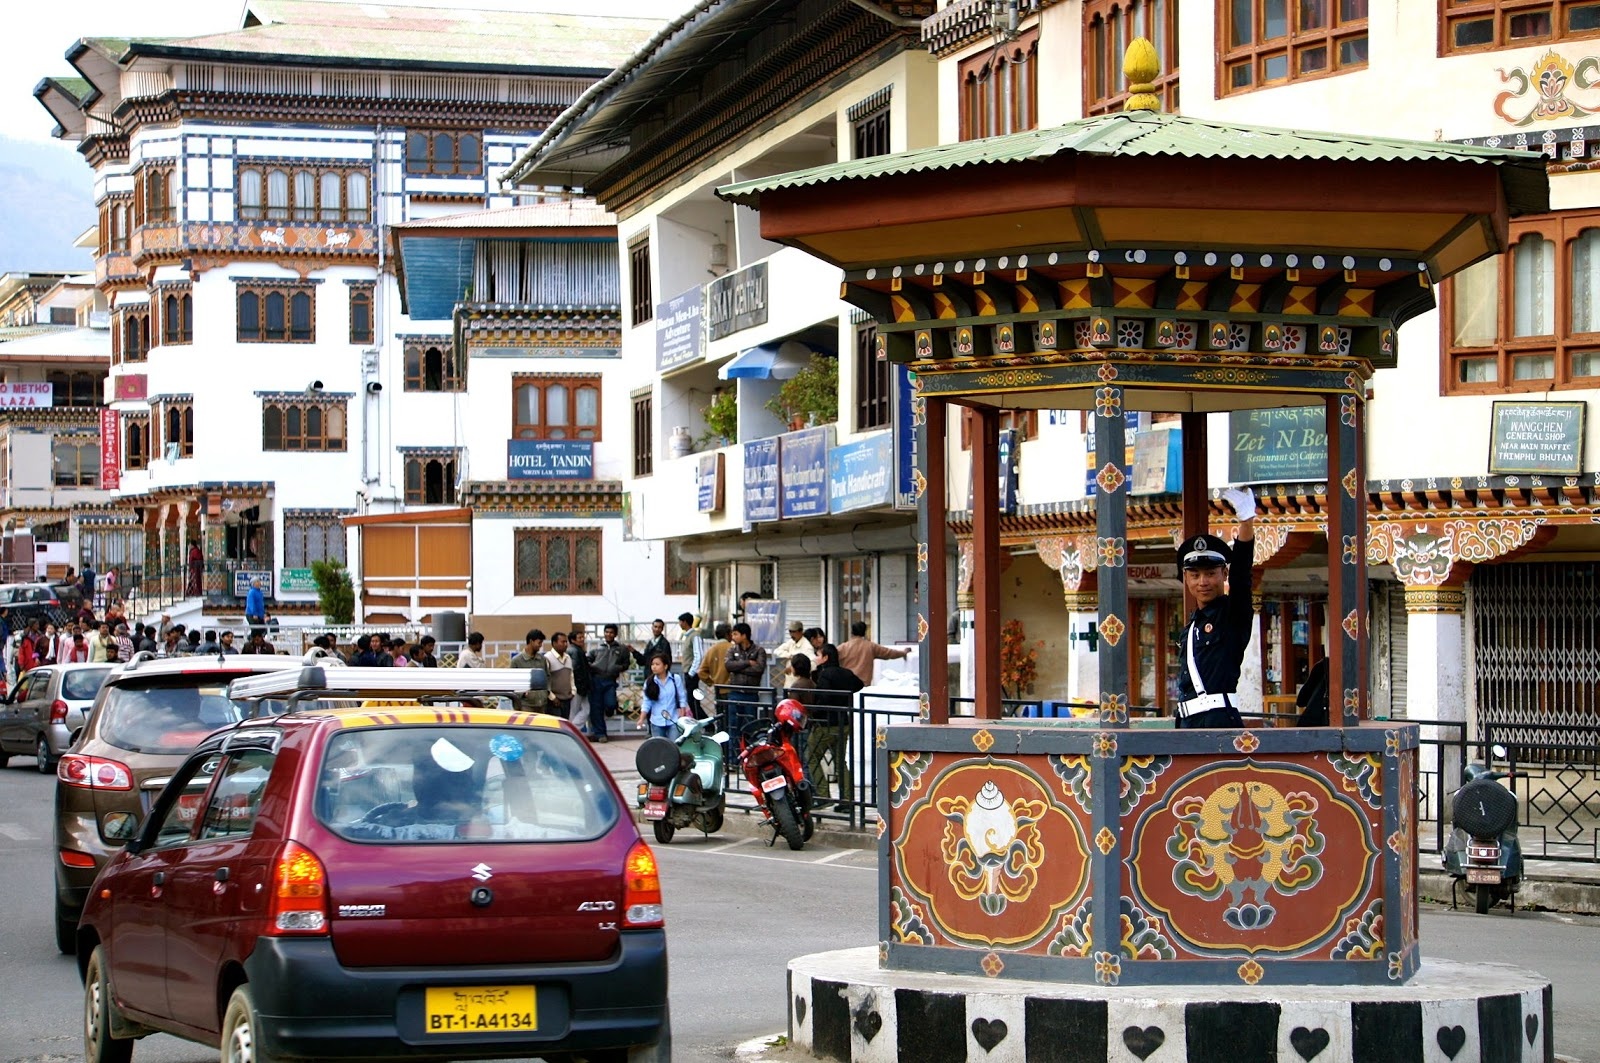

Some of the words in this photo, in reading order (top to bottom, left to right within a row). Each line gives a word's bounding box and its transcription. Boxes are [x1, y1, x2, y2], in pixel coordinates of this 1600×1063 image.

[736, 278, 764, 316] CENTRAL
[13, 384, 49, 393] METHO
[0, 396, 35, 406] LAZA
[1510, 422, 1563, 432] WANGCHEN
[1234, 433, 1266, 451] Zet
[1276, 430, 1296, 448] N
[1506, 432, 1543, 440] GENERAL
[1545, 433, 1566, 441] SHOP
[1501, 442, 1518, 450] NEAR
[509, 455, 546, 467] HOTEL
[551, 454, 592, 467] TANDIN
[1247, 453, 1287, 462] Restaurant
[1300, 450, 1328, 461] Caterin
[1499, 452, 1536, 460] THIMPHU
[832, 476, 846, 499] Druk
[848, 466, 885, 494] Handicraft
[1128, 566, 1162, 578] EDICAL
[577, 901, 616, 911] ALTO
[599, 922, 617, 930] LX
[431, 1013, 532, 1029] BT-1-A4134
